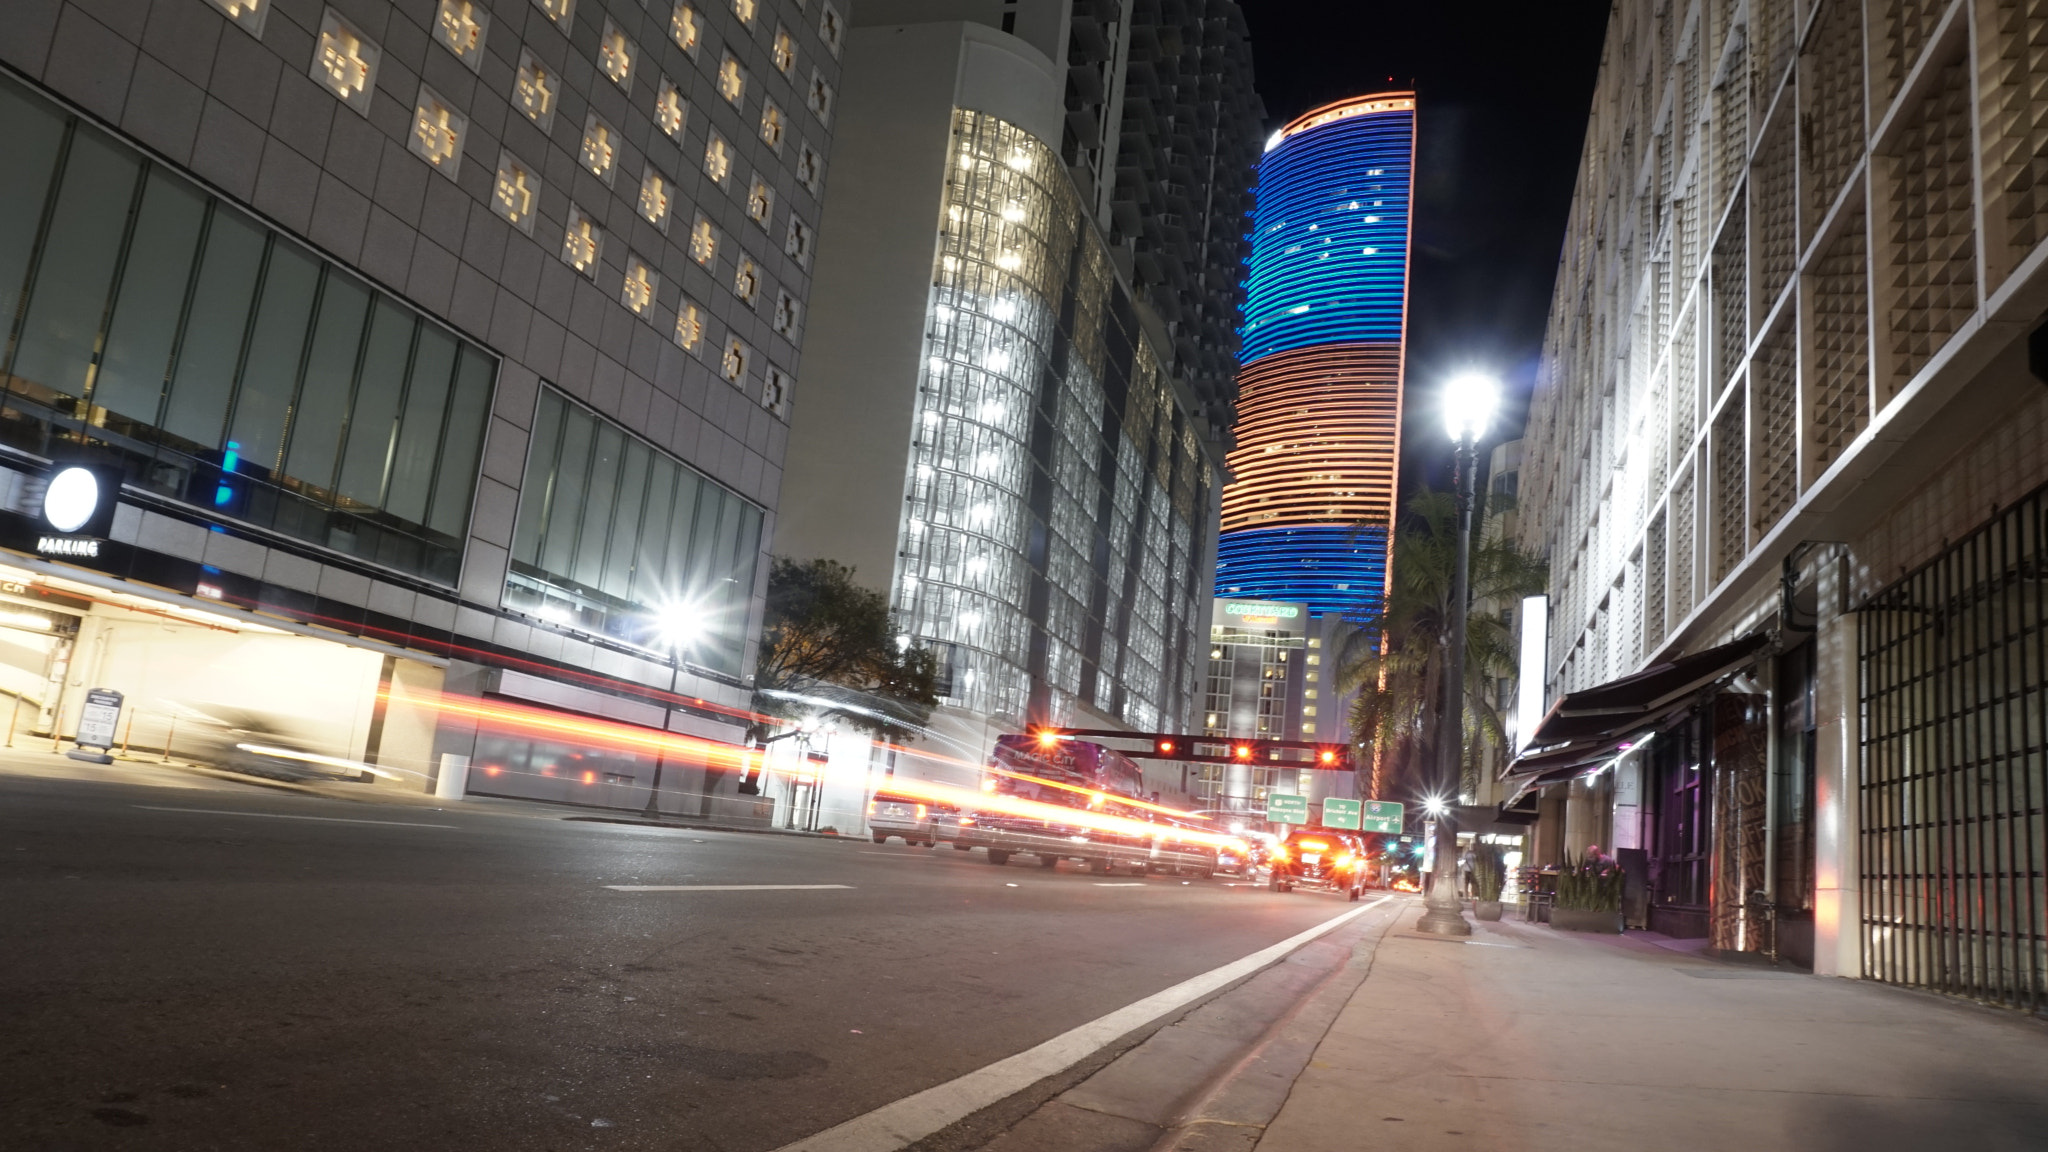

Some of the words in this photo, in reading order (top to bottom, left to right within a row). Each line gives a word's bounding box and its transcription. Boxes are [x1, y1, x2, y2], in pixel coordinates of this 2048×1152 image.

[38, 537, 98, 557] PARKING
[1014, 751, 1051, 763] MAGIC
[1053, 755, 1076, 765] CITY
[1365, 814, 1391, 823] Airport
